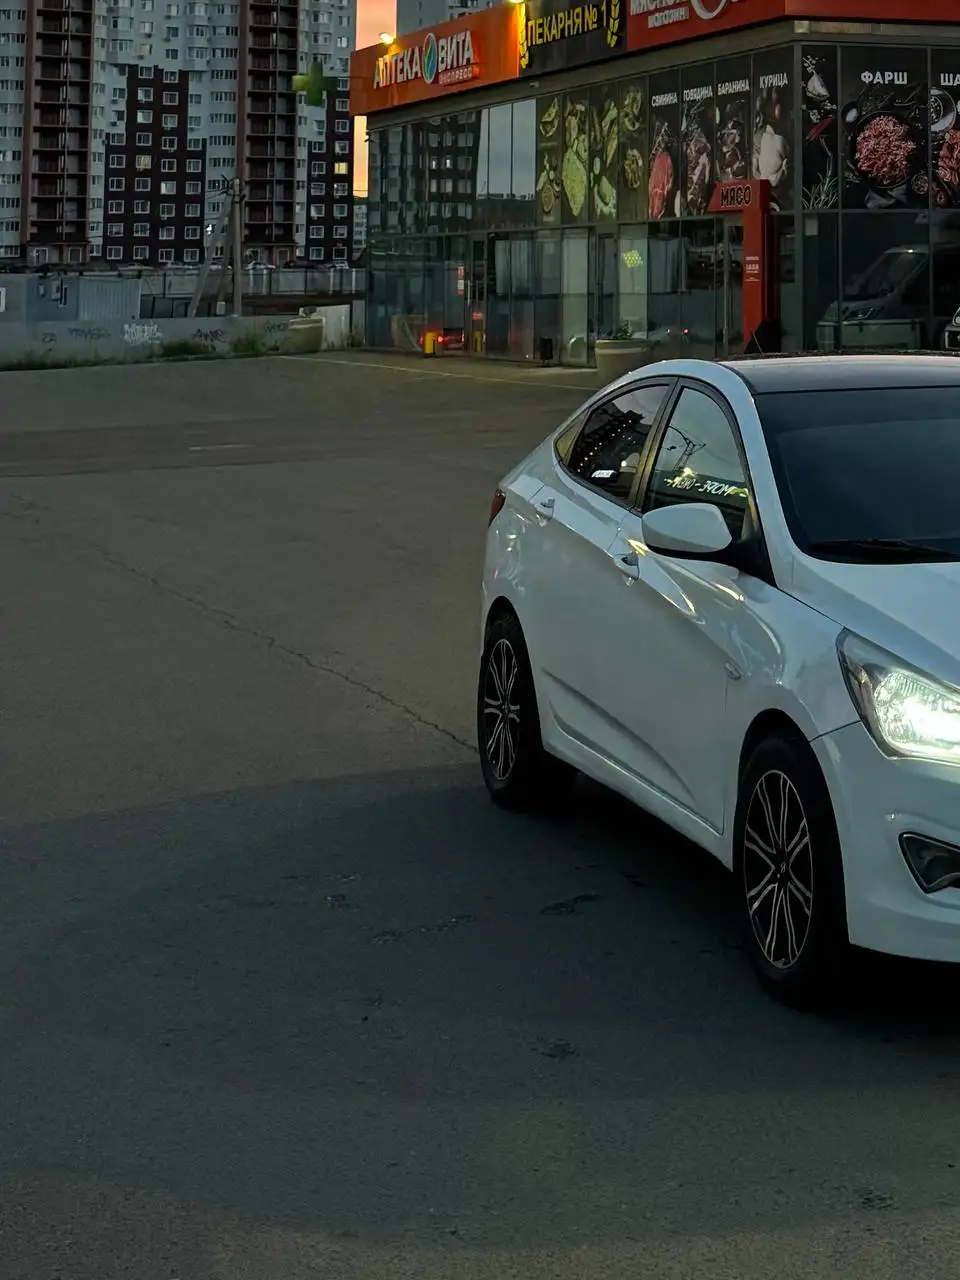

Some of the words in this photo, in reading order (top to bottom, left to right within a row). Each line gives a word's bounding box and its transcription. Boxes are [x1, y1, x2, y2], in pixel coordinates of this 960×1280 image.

[527, 8, 582, 46] ПЕКАРНЯ
[584, 5, 598, 31] №
[600, 5, 607, 27] 1
[438, 31, 472, 72] ВИТА
[373, 45, 421, 89] АПТЕКА
[759, 73, 789, 89] КУРИЦА
[861, 70, 908, 85] ФАРШ
[683, 85, 713, 102] ГОВЯДИНА
[717, 79, 750, 96] БАРАНИНА
[651, 92, 678, 108] СВИНИНА
[720, 185, 752, 208] МЯСО
